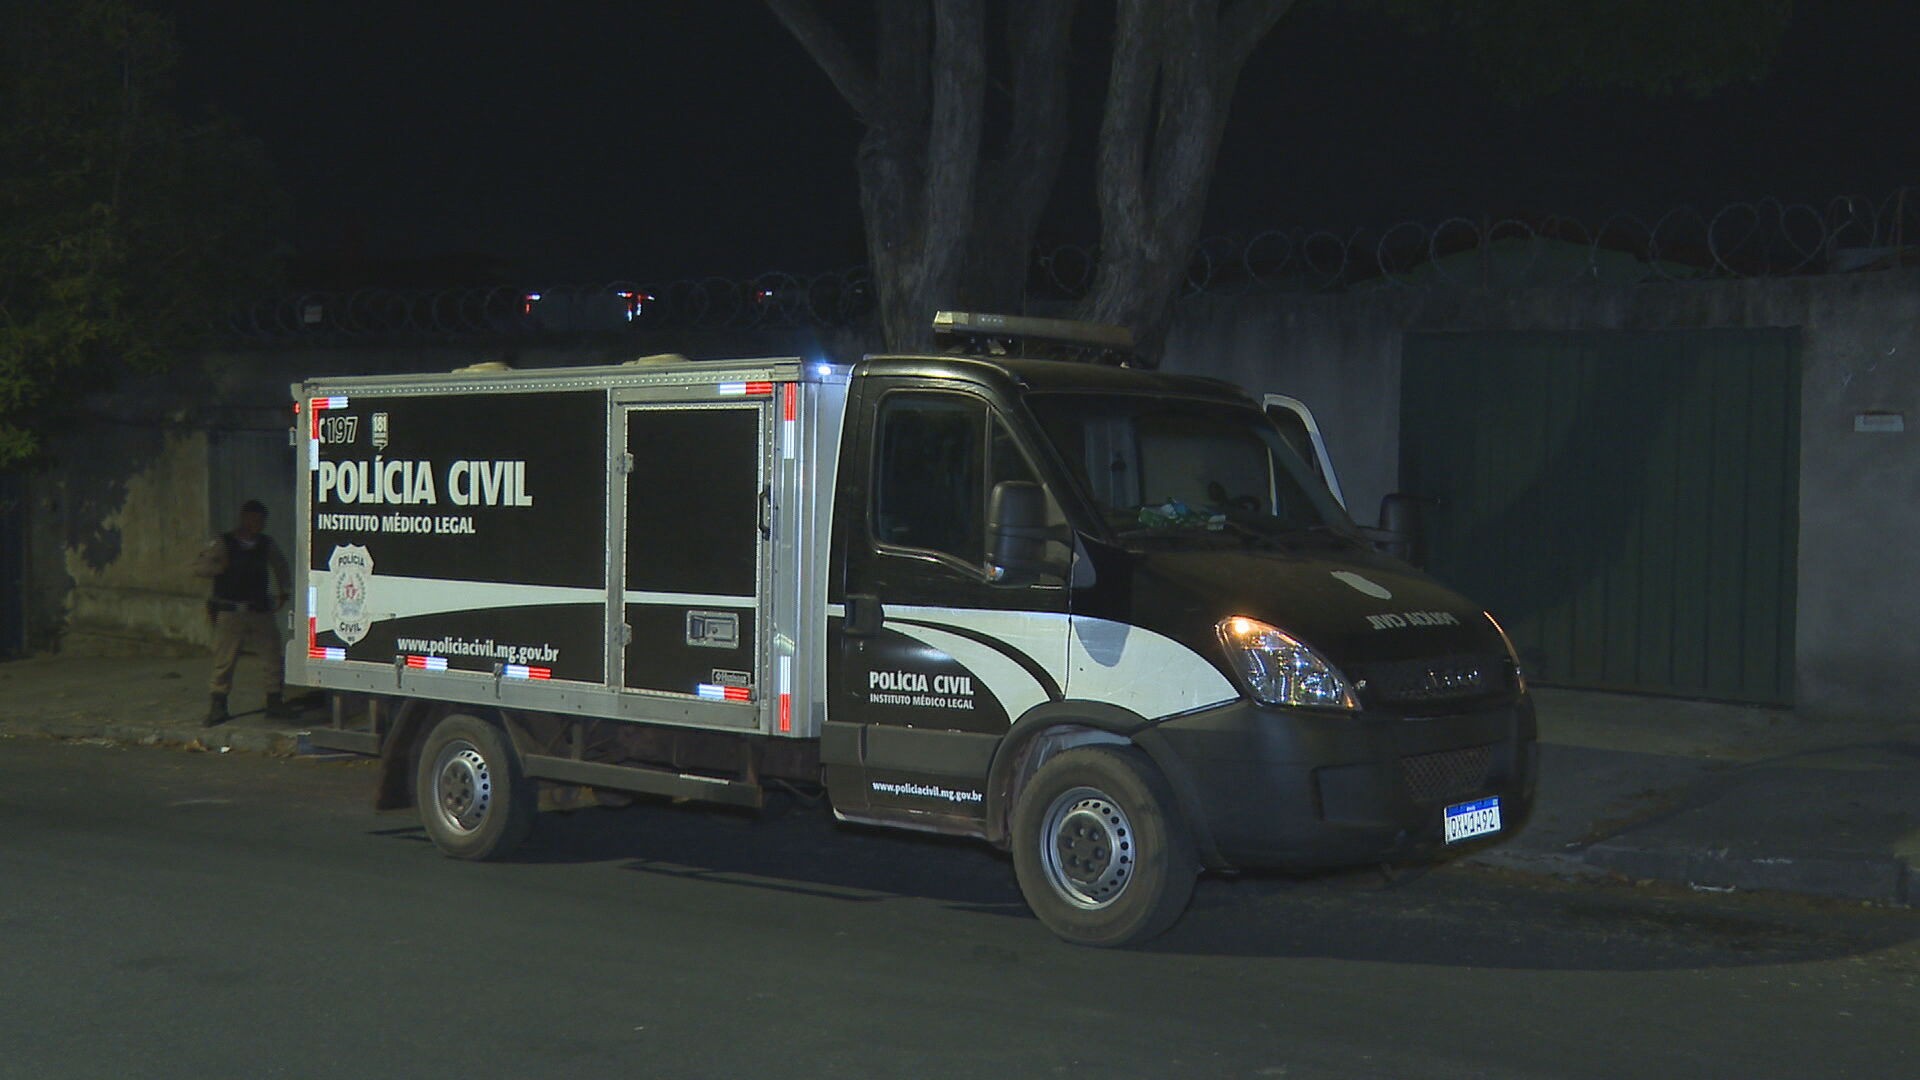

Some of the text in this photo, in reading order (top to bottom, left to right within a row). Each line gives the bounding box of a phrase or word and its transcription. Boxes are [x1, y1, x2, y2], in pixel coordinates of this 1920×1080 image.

[327, 415, 358, 444] 197
[318, 455, 533, 507] POLÍCIA CIVIL
[318, 513, 476, 534] INSTITUTO MÉDICO LEGAL
[340, 621, 362, 633] CIVIL
[397, 636, 560, 665] www.policiacivil.mg.gov.br
[869, 670, 975, 695] POLÍCIA CIVIL
[870, 693, 975, 710] INSTITUTO MÉDICO LEGAL
[872, 781, 983, 802] www.policiacivil.mg.gov.br
